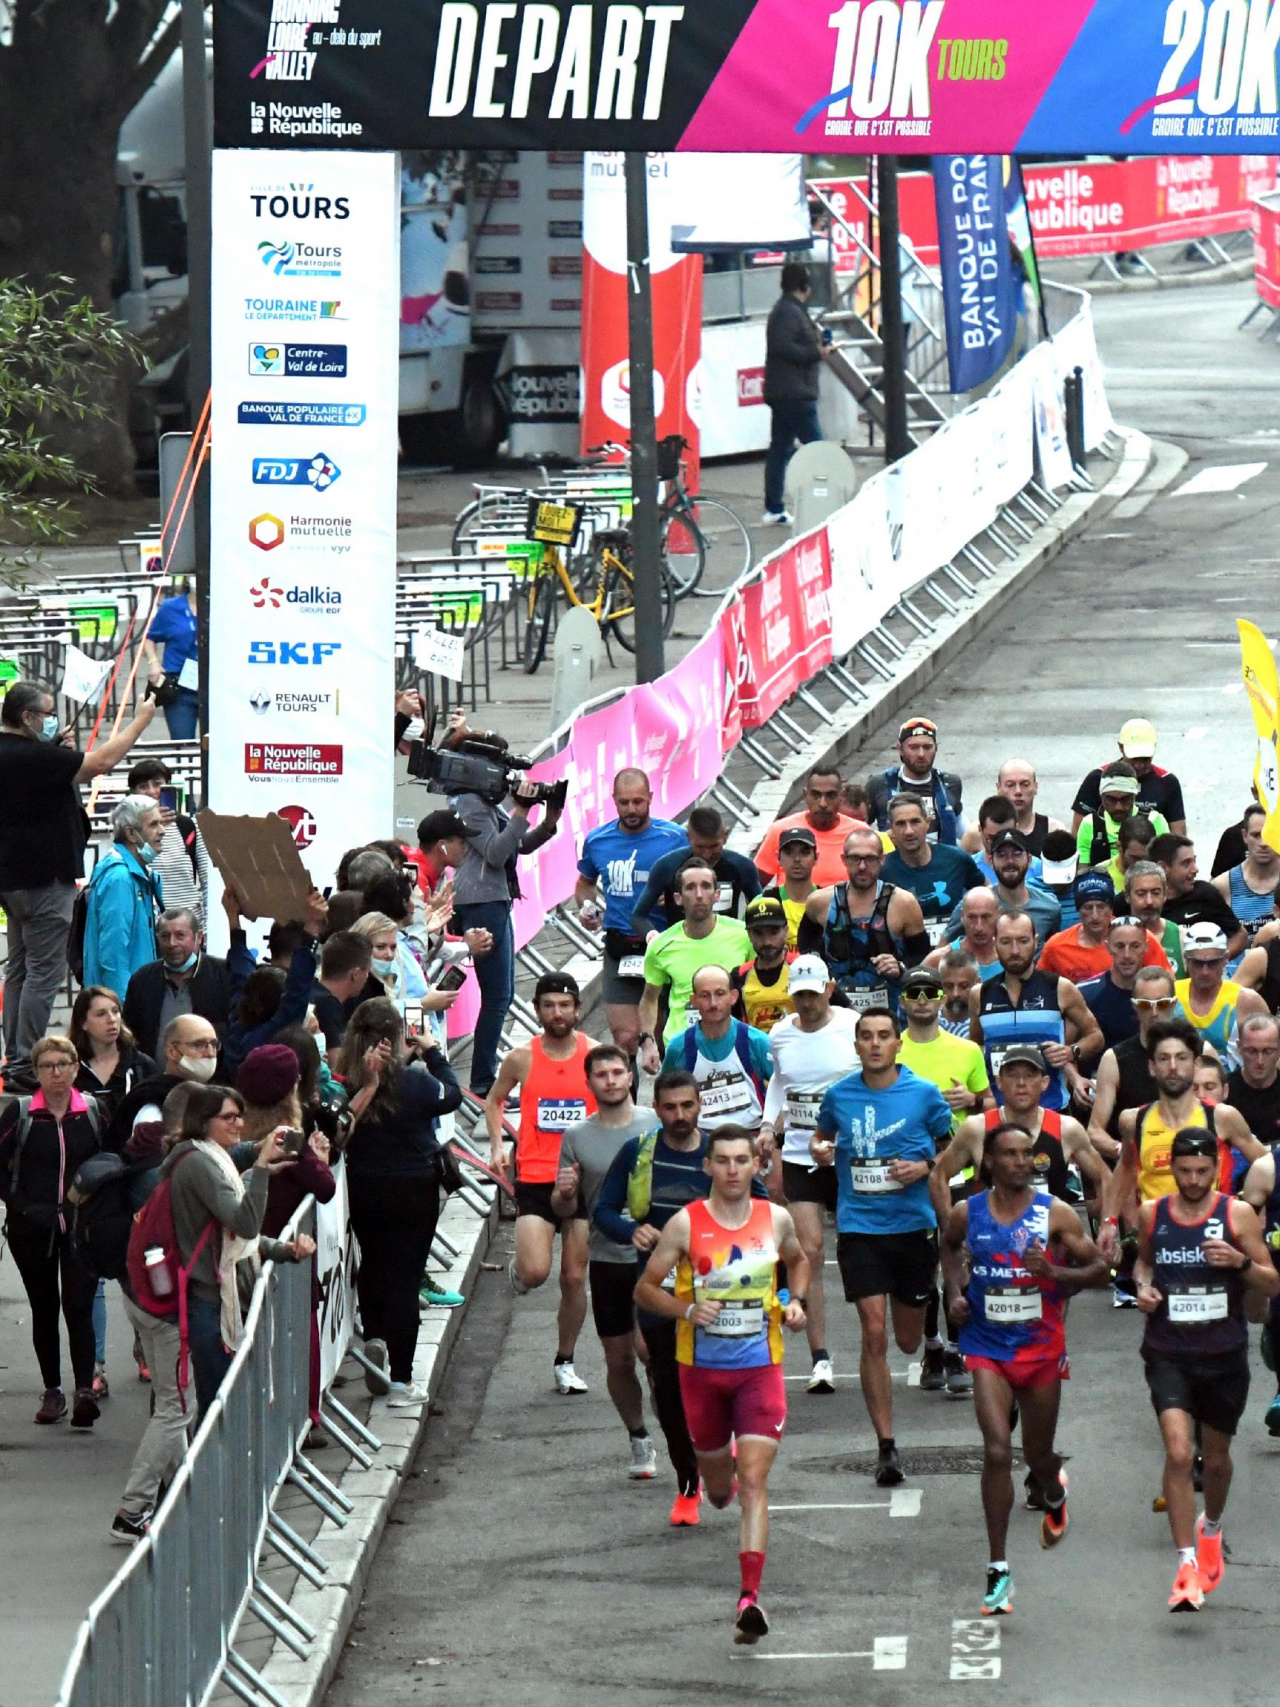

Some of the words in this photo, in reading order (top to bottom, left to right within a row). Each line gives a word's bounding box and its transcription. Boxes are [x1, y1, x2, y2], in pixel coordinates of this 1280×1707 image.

[267, 23, 310, 50] LOIRE
[348, 30, 358, 45] du
[359, 30, 382, 48] sport
[265, 52, 317, 80] VALLEY
[428, 2, 684, 120] DEPART
[827, 0, 945, 118] 10K
[937, 38, 1008, 81] TOURS
[251, 102, 265, 118] la
[269, 102, 342, 119] Nouvelle
[269, 118, 363, 138] République
[825, 120, 852, 135] CROIRE
[854, 120, 869, 136] QUE
[895, 121, 932, 136] POSSIBLE
[1152, 117, 1185, 137] CROIRE
[1187, 117, 1204, 137] QUE
[1235, 117, 1280, 136] POSSIBLE
[1025, 169, 1094, 201] uvelle
[969, 155, 994, 231] FRAN
[250, 195, 350, 220] TOURS
[294, 242, 342, 258] Tours
[978, 238, 998, 280] DE
[954, 213, 985, 349] BANQUE
[245, 298, 317, 312] TOURAINE
[245, 312, 254, 320] LE
[287, 362, 304, 372] Val
[305, 362, 318, 373] de
[320, 363, 345, 373] Loire
[242, 404, 286, 414] BANQUE
[287, 405, 344, 415] POPULAIRE
[269, 413, 287, 423] VAL
[290, 414, 302, 423] DE
[304, 415, 344, 424] FRANCE
[255, 462, 299, 481] FDJ
[290, 515, 352, 527] Harmonie
[290, 526, 352, 537] mutuelle
[286, 586, 342, 604] dalkia
[248, 641, 342, 665] SKF
[275, 693, 331, 703] RENAULT
[275, 703, 317, 712] TOURS
[249, 745, 260, 758] la
[264, 746, 321, 760] Nouvelle
[264, 758, 337, 773] République
[622, 960, 642, 968] 4242
[701, 1092, 731, 1107] 42413
[542, 1110, 581, 1121] 20422
[789, 1107, 813, 1119] 42114
[854, 1171, 882, 1184] 42108
[1156, 1246, 1207, 1265] absisk
[987, 1303, 1021, 1313] 42018
[1172, 1303, 1207, 1314] 42014
[714, 1317, 742, 1327] 2003
